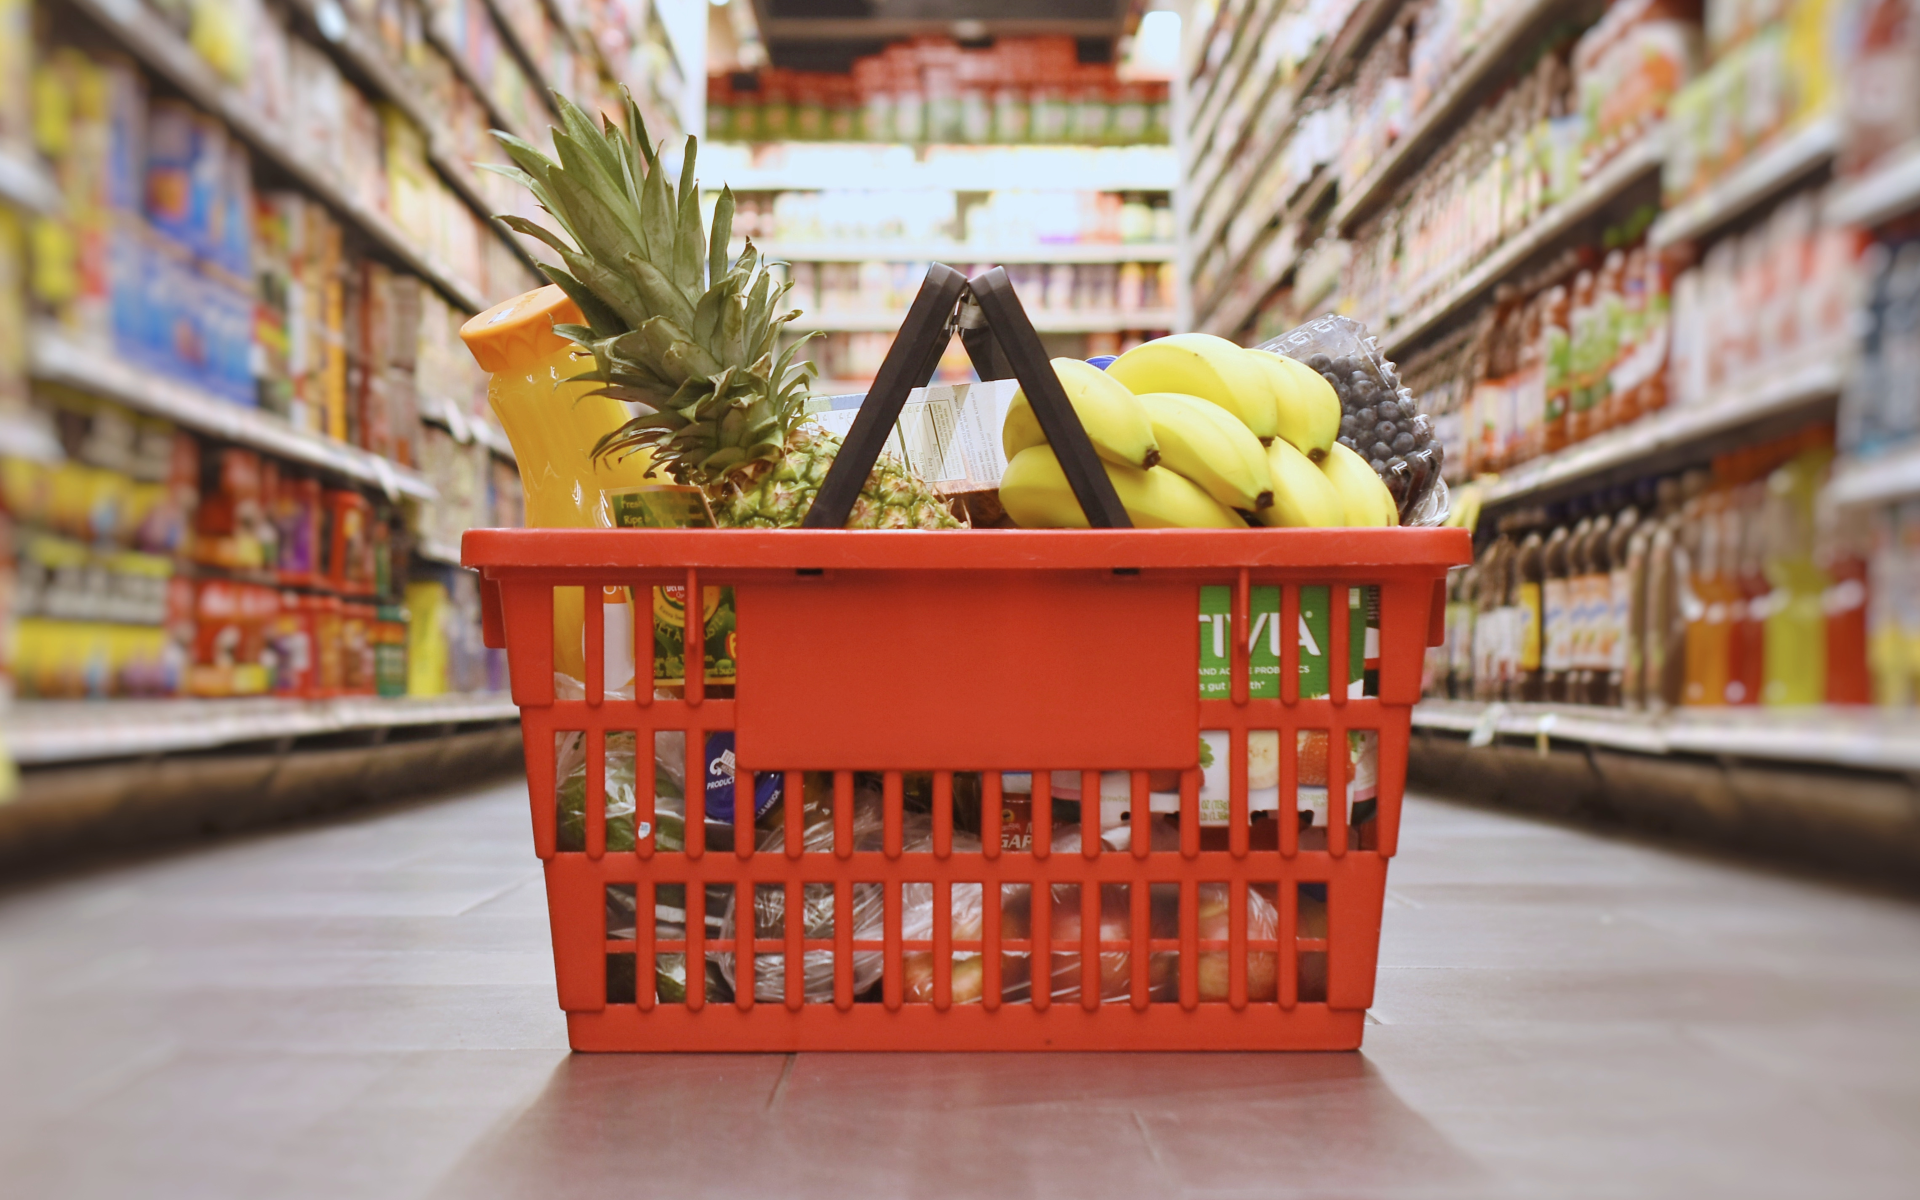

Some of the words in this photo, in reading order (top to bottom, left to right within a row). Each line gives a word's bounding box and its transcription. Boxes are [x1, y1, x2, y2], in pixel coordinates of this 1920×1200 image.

[624, 515, 643, 528] Ripe
[1254, 665, 1310, 674] PROBCS
[1208, 682, 1226, 692] gut
